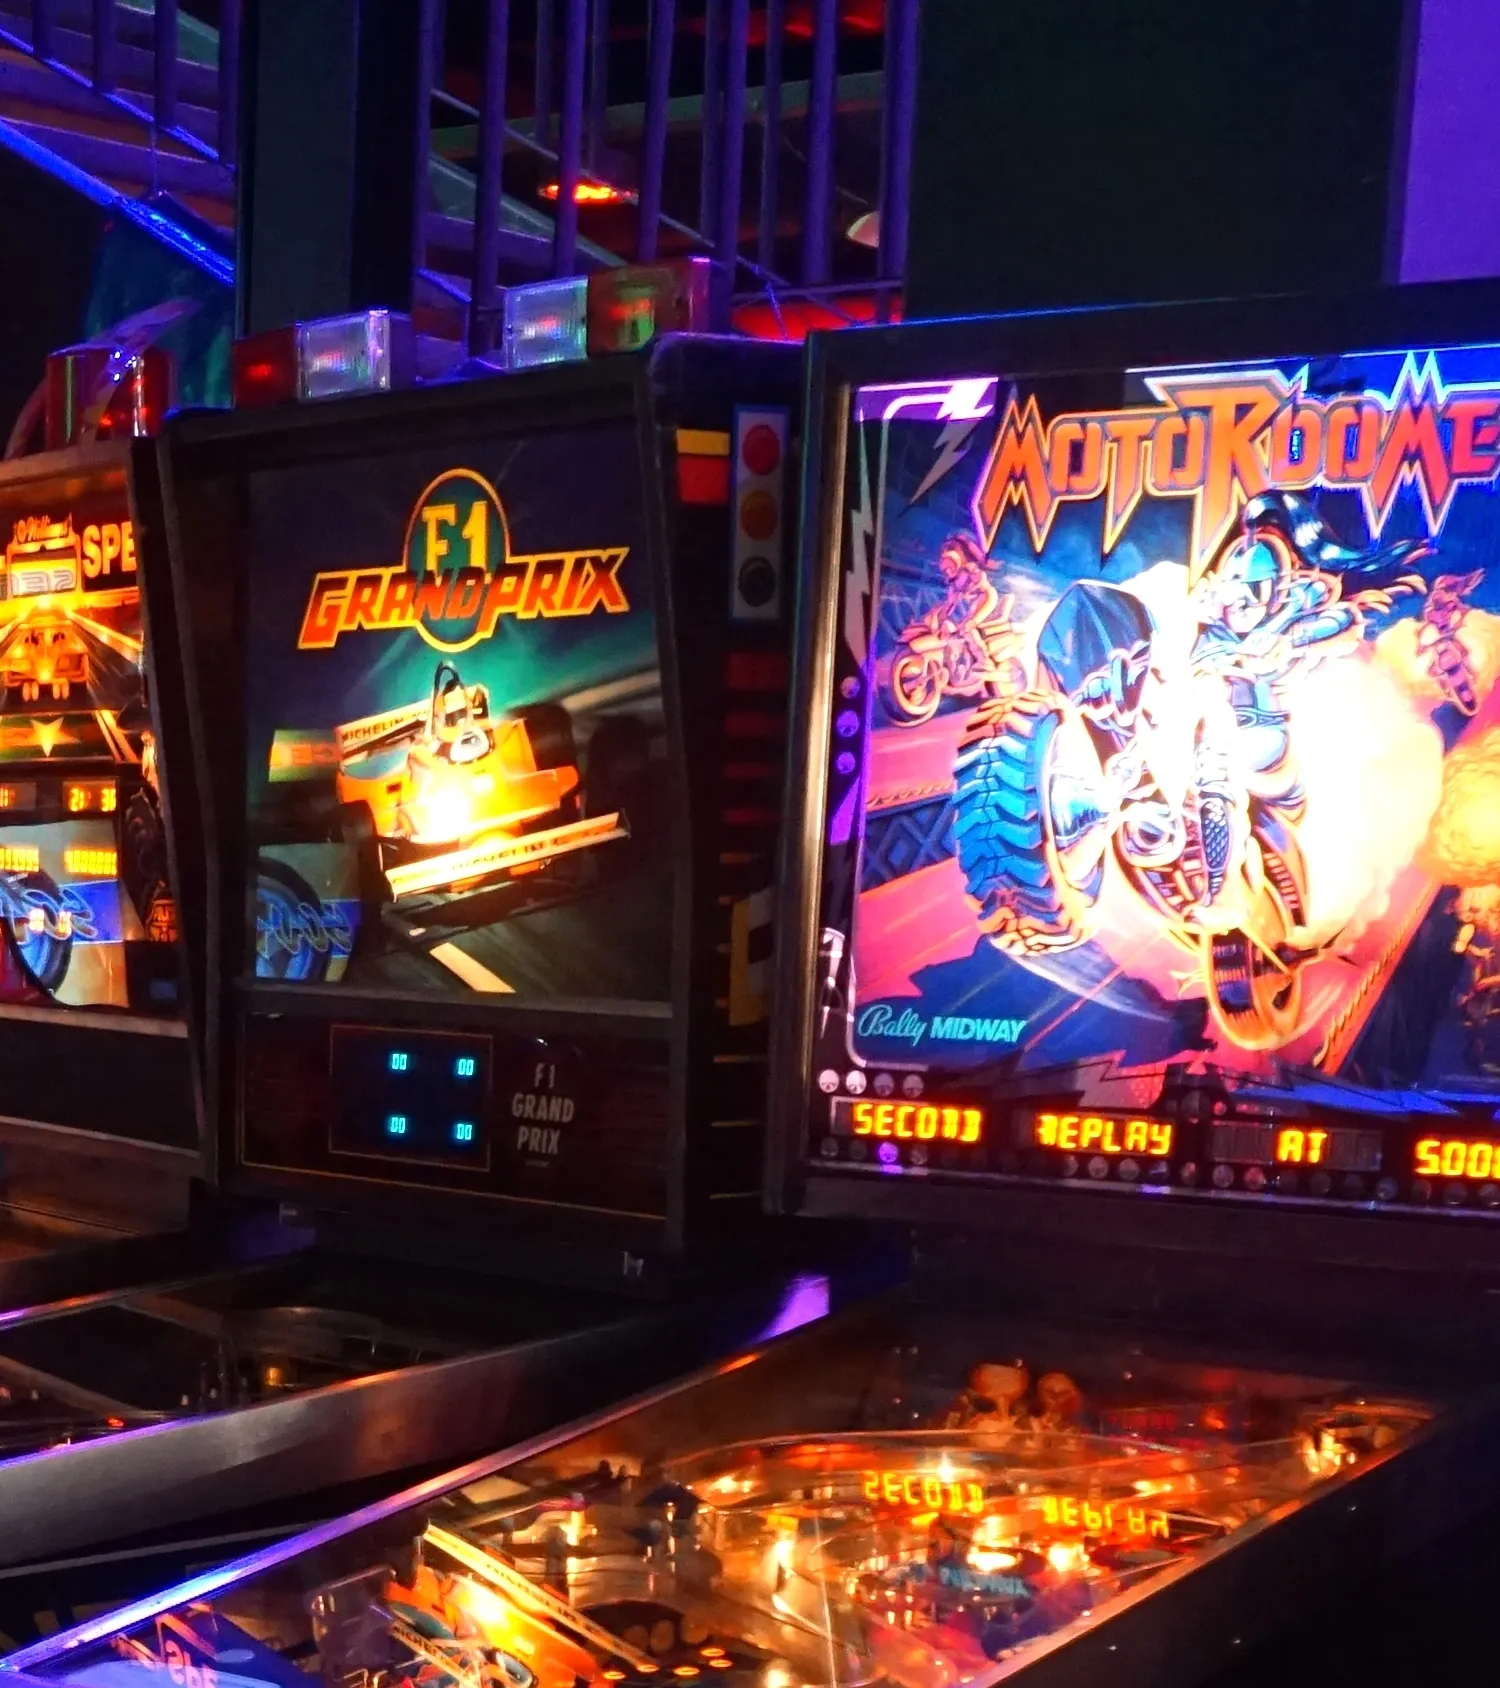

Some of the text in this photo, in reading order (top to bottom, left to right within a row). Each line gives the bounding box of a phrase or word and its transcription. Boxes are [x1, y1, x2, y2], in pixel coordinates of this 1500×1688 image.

[421, 499, 488, 572] F1
[298, 547, 630, 649] GRAND PRIX
[857, 1003, 1028, 1046] Bally MIDWAY
[511, 1092, 576, 1125] GRAND
[517, 1126, 561, 1156] PRIX
[1276, 1129, 1329, 1164] AT
